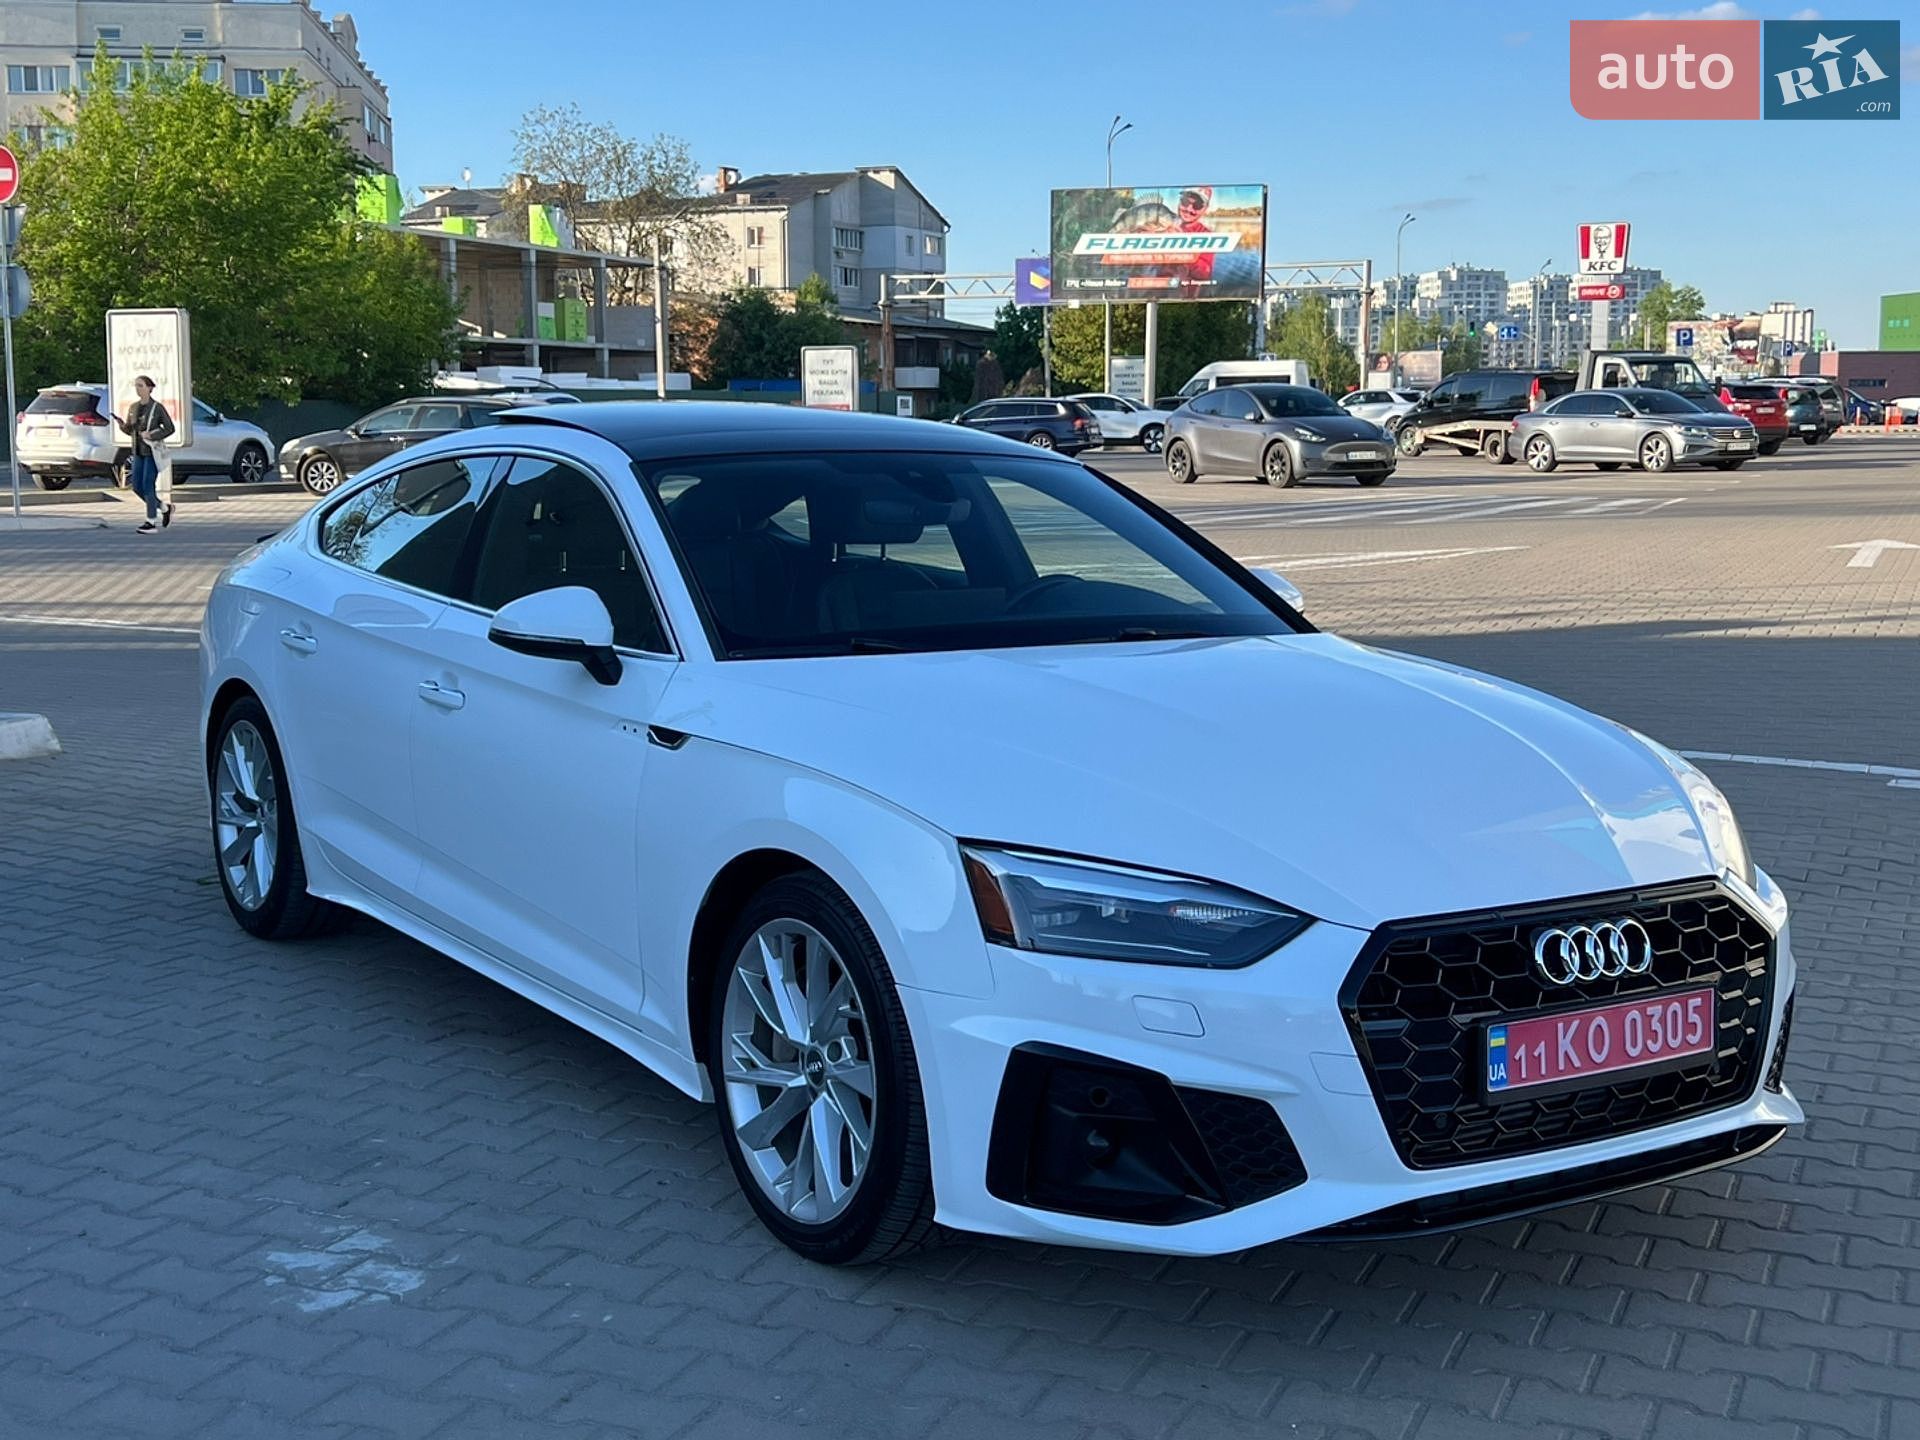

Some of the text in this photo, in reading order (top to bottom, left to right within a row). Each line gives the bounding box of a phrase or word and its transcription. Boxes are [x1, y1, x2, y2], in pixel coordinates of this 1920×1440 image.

[1086, 235, 1230, 251] FLAGMAN
[1586, 260, 1618, 272] KFC
[1624, 997, 1703, 1058] 0305
[1489, 1063, 1507, 1083] UA
